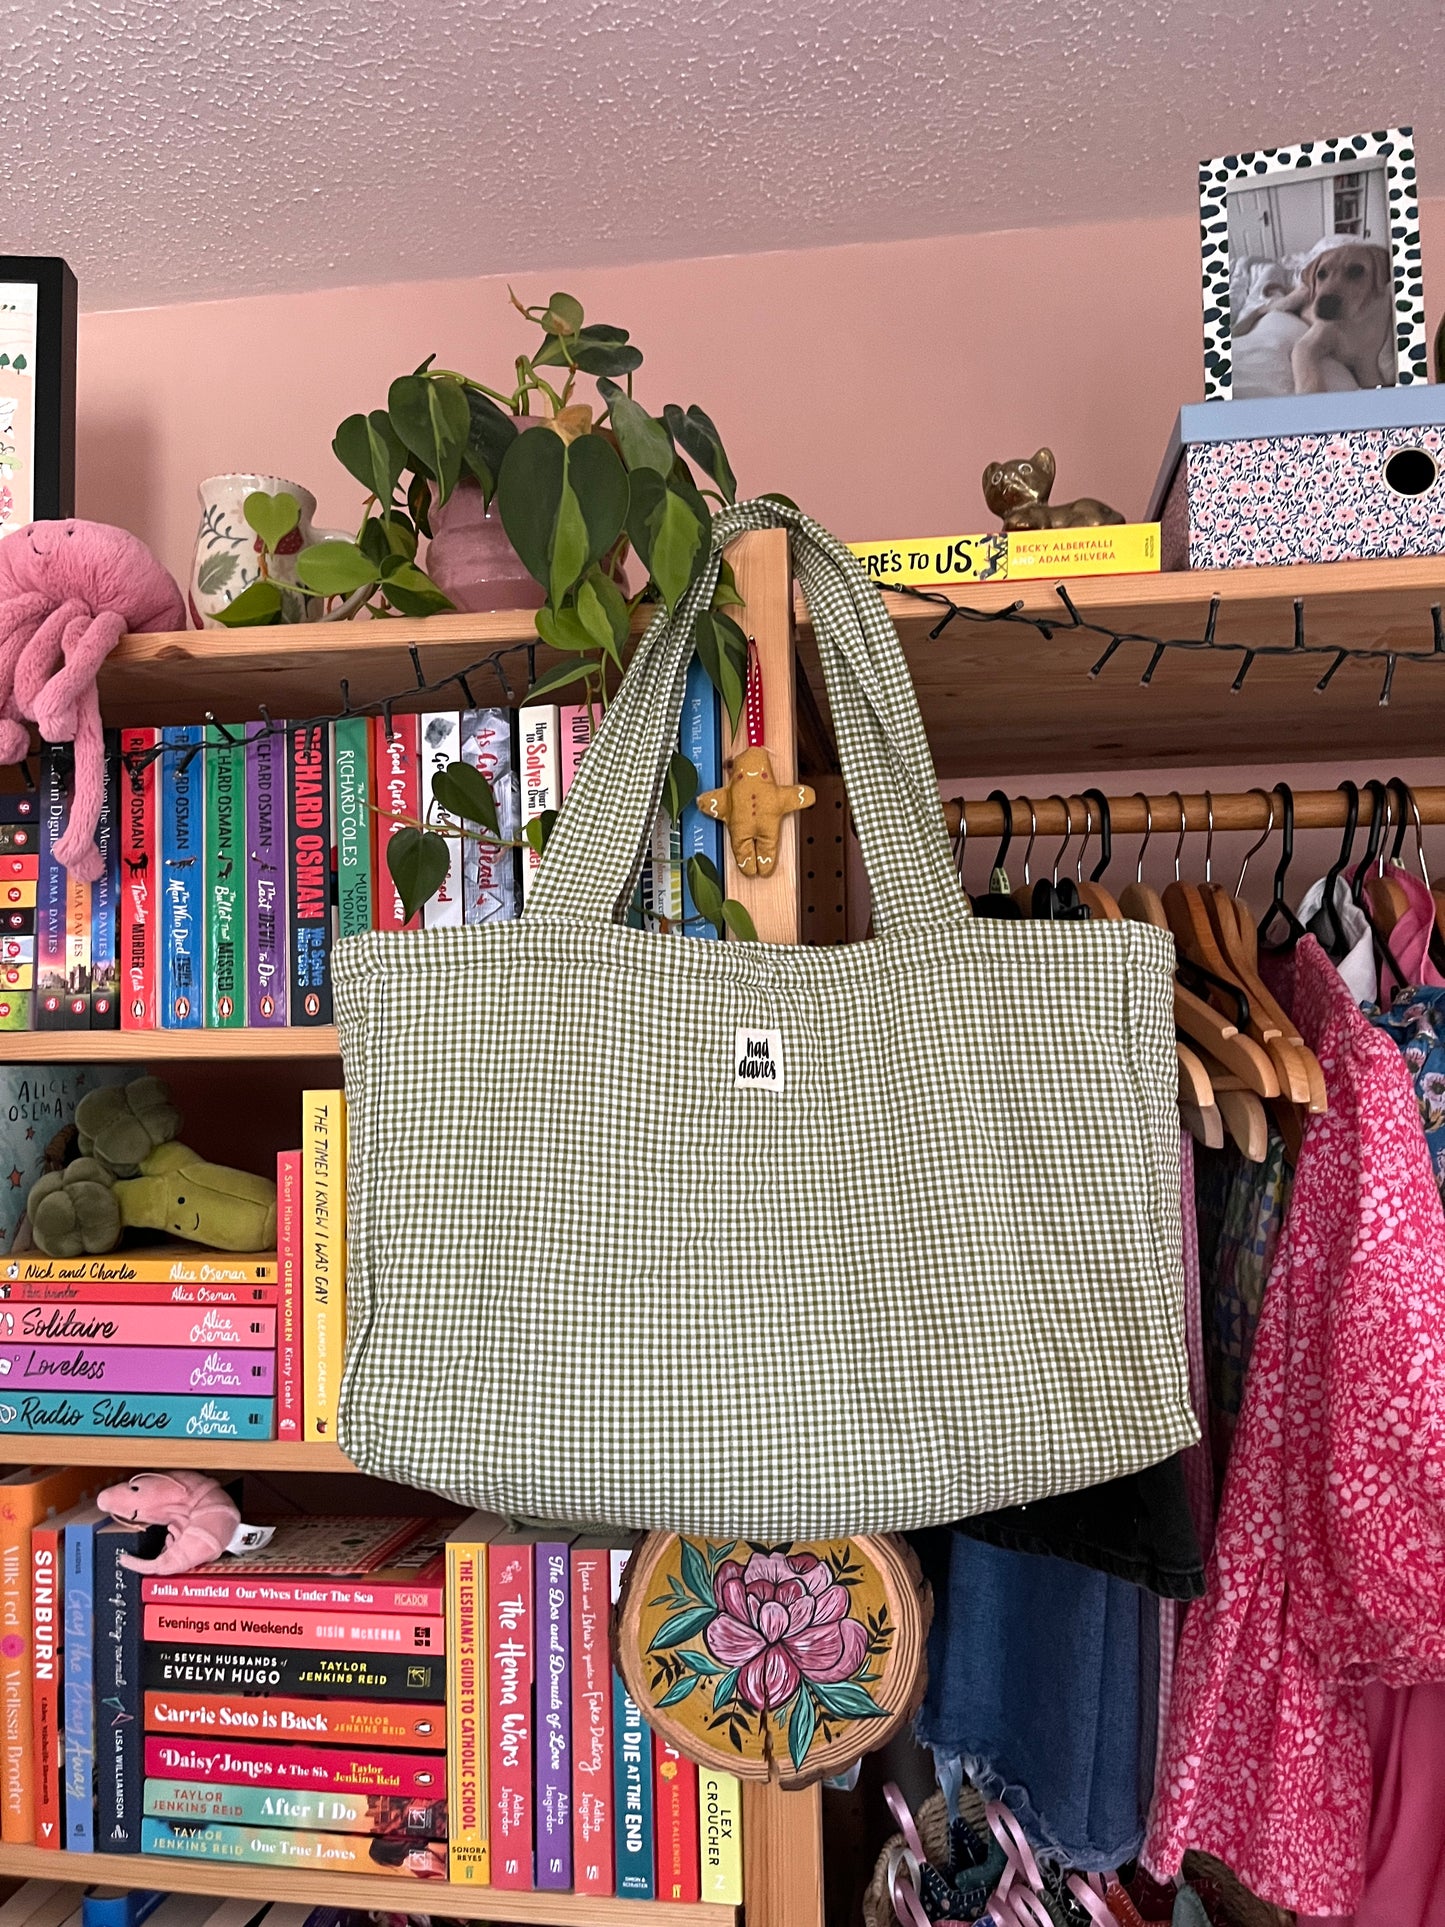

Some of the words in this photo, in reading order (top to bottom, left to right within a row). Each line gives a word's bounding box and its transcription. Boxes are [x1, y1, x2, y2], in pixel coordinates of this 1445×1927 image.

[908, 552, 929, 570] TO
[935, 539, 972, 574] US
[1012, 556, 1035, 566] AND
[1039, 554, 1070, 564] ADAM
[1074, 551, 1116, 562] SILVERA
[1015, 543, 1048, 554] BECKY
[1053, 539, 1113, 551] ALBERTALLI
[692, 698, 703, 714] Be
[477, 727, 496, 748] As
[535, 721, 548, 743] How
[571, 715, 590, 745] HOW
[386, 742, 406, 776] Good
[523, 743, 548, 790] Solve
[692, 746, 703, 763] Be
[337, 750, 357, 815] RICHARD
[537, 787, 550, 809] Your
[387, 779, 407, 818] Girl's
[527, 788, 537, 809] Own
[131, 798, 145, 850] OSMAN
[175, 797, 189, 850] OSMAN
[217, 795, 233, 849] OSMAN
[257, 793, 273, 848] OSMAN
[341, 817, 358, 867] COLES
[295, 835, 325, 919] OSMAN
[477, 839, 501, 891] Dead
[49, 866, 58, 904] EMMA
[258, 879, 275, 912] Last
[172, 904, 193, 928] Who
[214, 885, 233, 923] Bullet
[49, 908, 58, 954] DAVIES
[74, 912, 84, 958] DAVIES
[99, 911, 108, 958] DAVIES
[131, 923, 145, 968] MURDER
[172, 928, 191, 955] Died
[311, 926, 326, 947] We
[129, 967, 144, 992] Club
[217, 942, 234, 991] MISSED
[257, 963, 275, 988] Die
[311, 949, 326, 987] Solve
[746, 1037, 770, 1059] had
[738, 1056, 777, 1080] davies
[18, 1081, 70, 1103] ALICE
[314, 1105, 329, 1136] THE
[314, 1140, 329, 1178] TIMES
[283, 1174, 293, 1201] Short
[281, 1206, 293, 1242] History
[314, 1190, 329, 1230] KNEW
[24, 1262, 55, 1279] Nick
[59, 1263, 87, 1279] and
[89, 1262, 138, 1280] Charlie
[169, 1261, 197, 1281] Alice
[200, 1264, 247, 1281] Oseman
[314, 1242, 329, 1273] WAS
[171, 1285, 195, 1301] Alice
[197, 1287, 236, 1301] Oseman
[284, 1260, 293, 1295] QUEER
[314, 1276, 329, 1305] GAY
[22, 1307, 119, 1339] Solitaire
[190, 1324, 241, 1342] Oseman
[202, 1308, 233, 1330] Alice
[284, 1299, 293, 1342] WOMEN
[24, 1350, 106, 1380] Loveless
[189, 1367, 242, 1386] Oseman
[202, 1351, 234, 1373] Alice
[282, 1347, 293, 1377] Kirsty
[20, 1396, 84, 1430] Radio
[92, 1398, 172, 1429] Silence
[186, 1415, 239, 1435] Oseman
[199, 1399, 231, 1421] Alice
[460, 1559, 473, 1582] THE
[548, 1555, 565, 1584] The
[577, 1561, 598, 1593] Hani
[151, 1584, 179, 1596] Julia
[181, 1585, 230, 1598] Armfield
[235, 1587, 258, 1599] Our
[259, 1588, 291, 1600] Wives
[294, 1589, 328, 1601] Under
[330, 1590, 351, 1603] The
[353, 1591, 375, 1604] Sea
[394, 1593, 429, 1607] PICADOR
[549, 1587, 565, 1621] Dos
[34, 1550, 53, 1680] SUNBURN
[460, 1586, 475, 1654] LESBIANA'S
[497, 1593, 527, 1631] The
[158, 1616, 210, 1633] Evenings
[213, 1619, 238, 1632] and
[240, 1620, 304, 1636] Weekends
[351, 1627, 402, 1641] McKENNA
[550, 1623, 565, 1653] and
[581, 1612, 597, 1652] Ishu's
[115, 1644, 127, 1688] normal
[163, 1665, 226, 1682] EVELYN
[231, 1668, 281, 1685] HUGO
[174, 1653, 212, 1664] SEVEN
[215, 1655, 278, 1668] HUSBANDS
[319, 1661, 368, 1673] TAYLOR
[494, 1637, 527, 1707] Henna
[299, 1671, 353, 1684] JENKINS
[358, 1674, 388, 1686] REID
[461, 1658, 475, 1696] GUIDE
[549, 1654, 565, 1711] Donuts
[154, 1703, 217, 1725] Carrie
[219, 1707, 260, 1727] Soto
[262, 1710, 278, 1729] is
[281, 1711, 328, 1731] Back
[350, 1715, 389, 1725] TAYLOR
[461, 1699, 475, 1713] TO
[115, 1729, 124, 1753] LISA
[333, 1723, 378, 1735] JENKINS
[500, 1713, 528, 1768] Wars
[461, 1718, 476, 1778] CATHOLIC
[549, 1731, 566, 1771] Love
[578, 1726, 605, 1777] Dating
[623, 1731, 642, 1763] DIE
[159, 1748, 221, 1775] Daisy
[219, 1753, 273, 1779] Jones
[289, 1764, 309, 1777] The
[312, 1766, 329, 1778] Six
[333, 1771, 374, 1784] Jenkins
[376, 1774, 400, 1786] Reid
[350, 1762, 384, 1775] Taylor
[627, 1764, 640, 1782] AT
[7, 1746, 24, 1815] Broder
[115, 1755, 125, 1819] WILLIAMSON
[174, 1788, 223, 1802] TAYLOR
[153, 1800, 207, 1814] JENKINS
[212, 1804, 243, 1816] REID
[260, 1796, 311, 1817] After
[331, 1802, 358, 1821] Do
[462, 1781, 477, 1831] SCHOOL
[498, 1786, 513, 1837] Jaigirdar
[513, 1793, 525, 1827] Adiba
[542, 1783, 557, 1836] Jaigirdar
[557, 1791, 569, 1826] Adiba
[626, 1783, 642, 1811] THE
[578, 1791, 594, 1843] Jaigirdar
[593, 1798, 605, 1833] Adiba
[706, 1780, 720, 1866] CROUCHER
[720, 1809, 733, 1839] LEX
[153, 1837, 208, 1851] JENKINS
[212, 1844, 244, 1856] REID
[173, 1826, 223, 1841] TAYLOR
[624, 1813, 643, 1853] END
[672, 1820, 681, 1876] CALLENDER
[250, 1839, 277, 1853] One
[279, 1841, 312, 1856] True
[315, 1843, 357, 1861] Loves
[452, 1846, 488, 1855] SONORA
[457, 1854, 482, 1862] REYES
